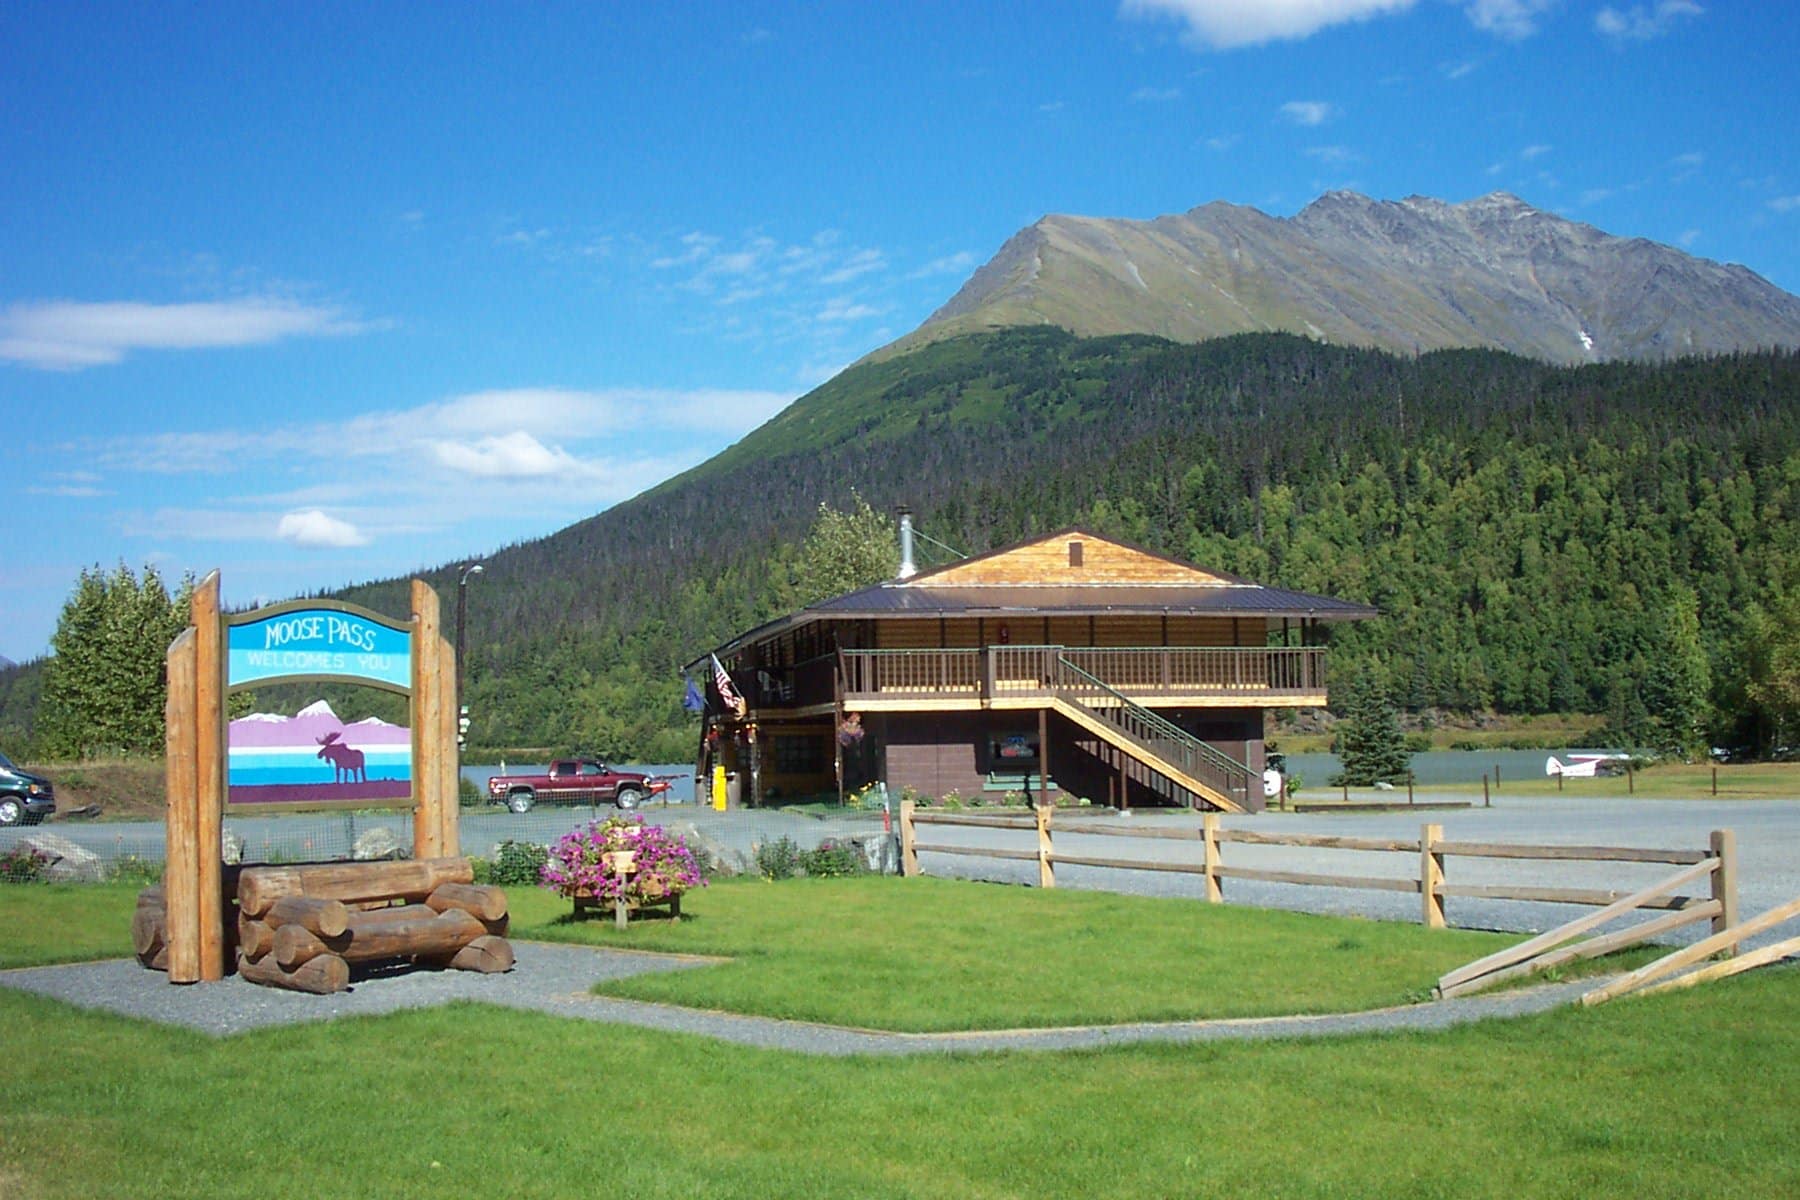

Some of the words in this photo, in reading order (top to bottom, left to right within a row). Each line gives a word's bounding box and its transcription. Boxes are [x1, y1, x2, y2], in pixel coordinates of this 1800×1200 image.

[265, 617, 325, 649] MOOSE
[328, 616, 377, 652] PASS
[247, 652, 345, 669] WELCOMES
[357, 653, 392, 671] YOU
